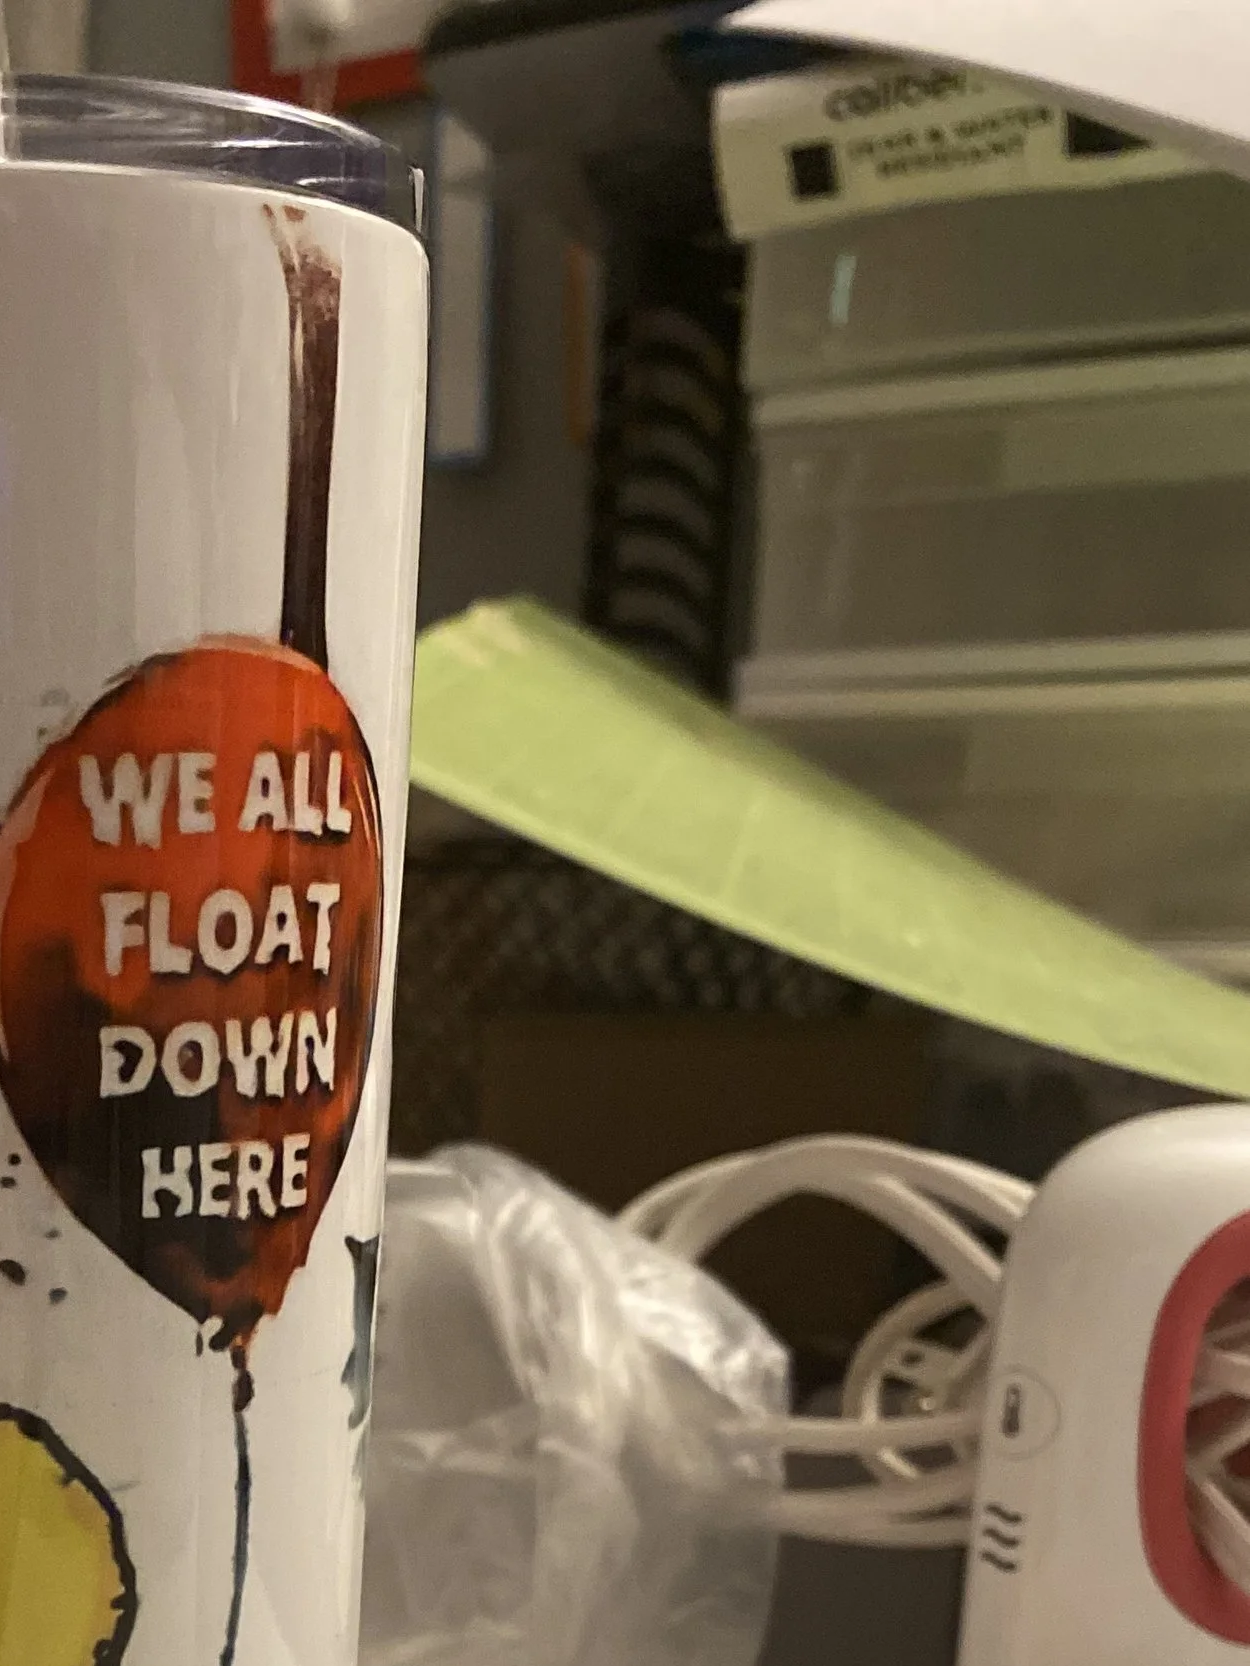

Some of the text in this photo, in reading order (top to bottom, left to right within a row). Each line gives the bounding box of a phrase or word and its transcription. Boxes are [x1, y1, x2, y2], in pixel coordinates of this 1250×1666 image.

[78, 749, 352, 849] WE ALL
[98, 882, 341, 977] FLOAT
[98, 1007, 338, 1099] DOWN
[141, 1132, 311, 1219] HERE
